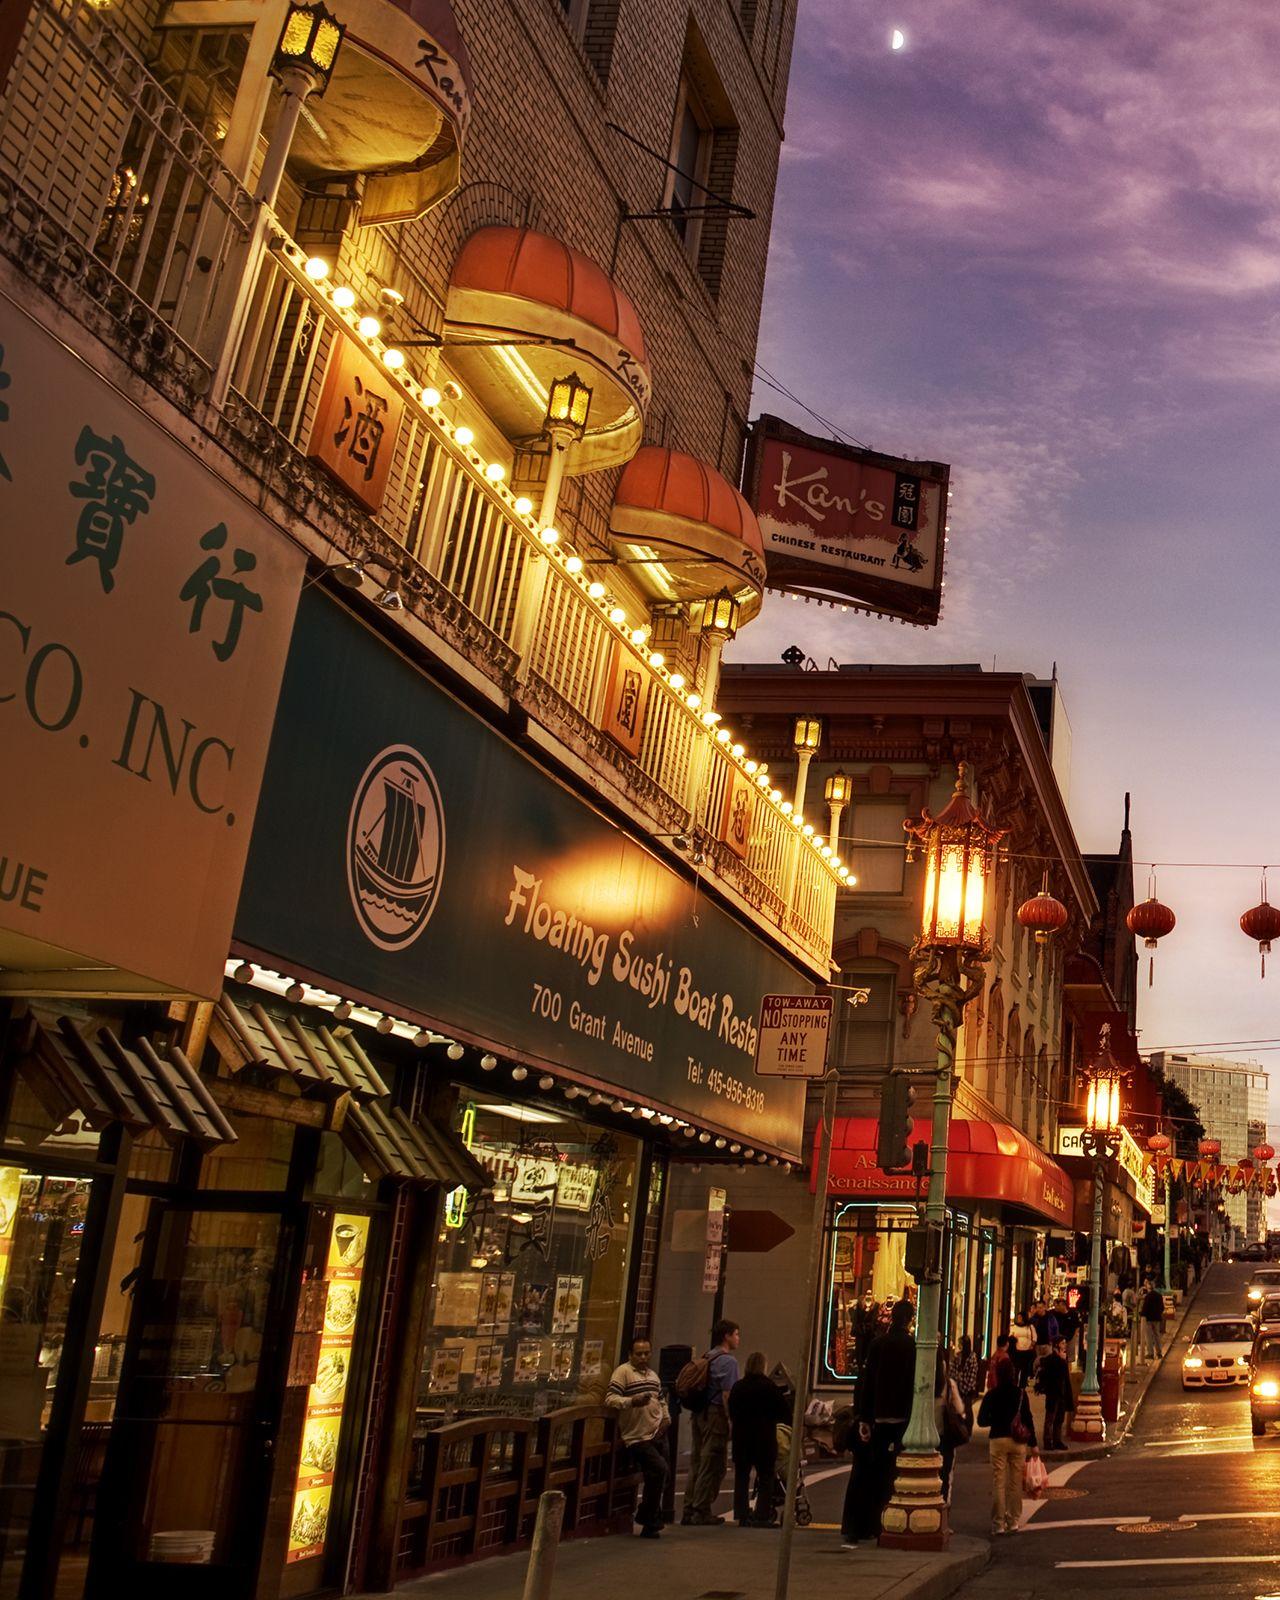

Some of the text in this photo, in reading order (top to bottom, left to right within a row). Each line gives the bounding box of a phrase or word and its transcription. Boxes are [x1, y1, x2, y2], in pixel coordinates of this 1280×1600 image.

[333, 375, 388, 481] 酒
[773, 450, 887, 522] Kan's
[771, 533, 886, 567] CHINESE RESTAURANT
[112, 686, 236, 827] INC.
[0, 856, 48, 913] UE
[505, 864, 757, 1058] Floating Sushi Boat Resta
[531, 983, 654, 1062] 700 Grant Avenue
[762, 1009, 827, 1029] NO STOPPING
[767, 997, 828, 1009] TOW-AWAY
[777, 1048, 807, 1062] TIME
[780, 1032, 808, 1046] ANY
[687, 1057, 765, 1115] Tel: 415-956-8318
